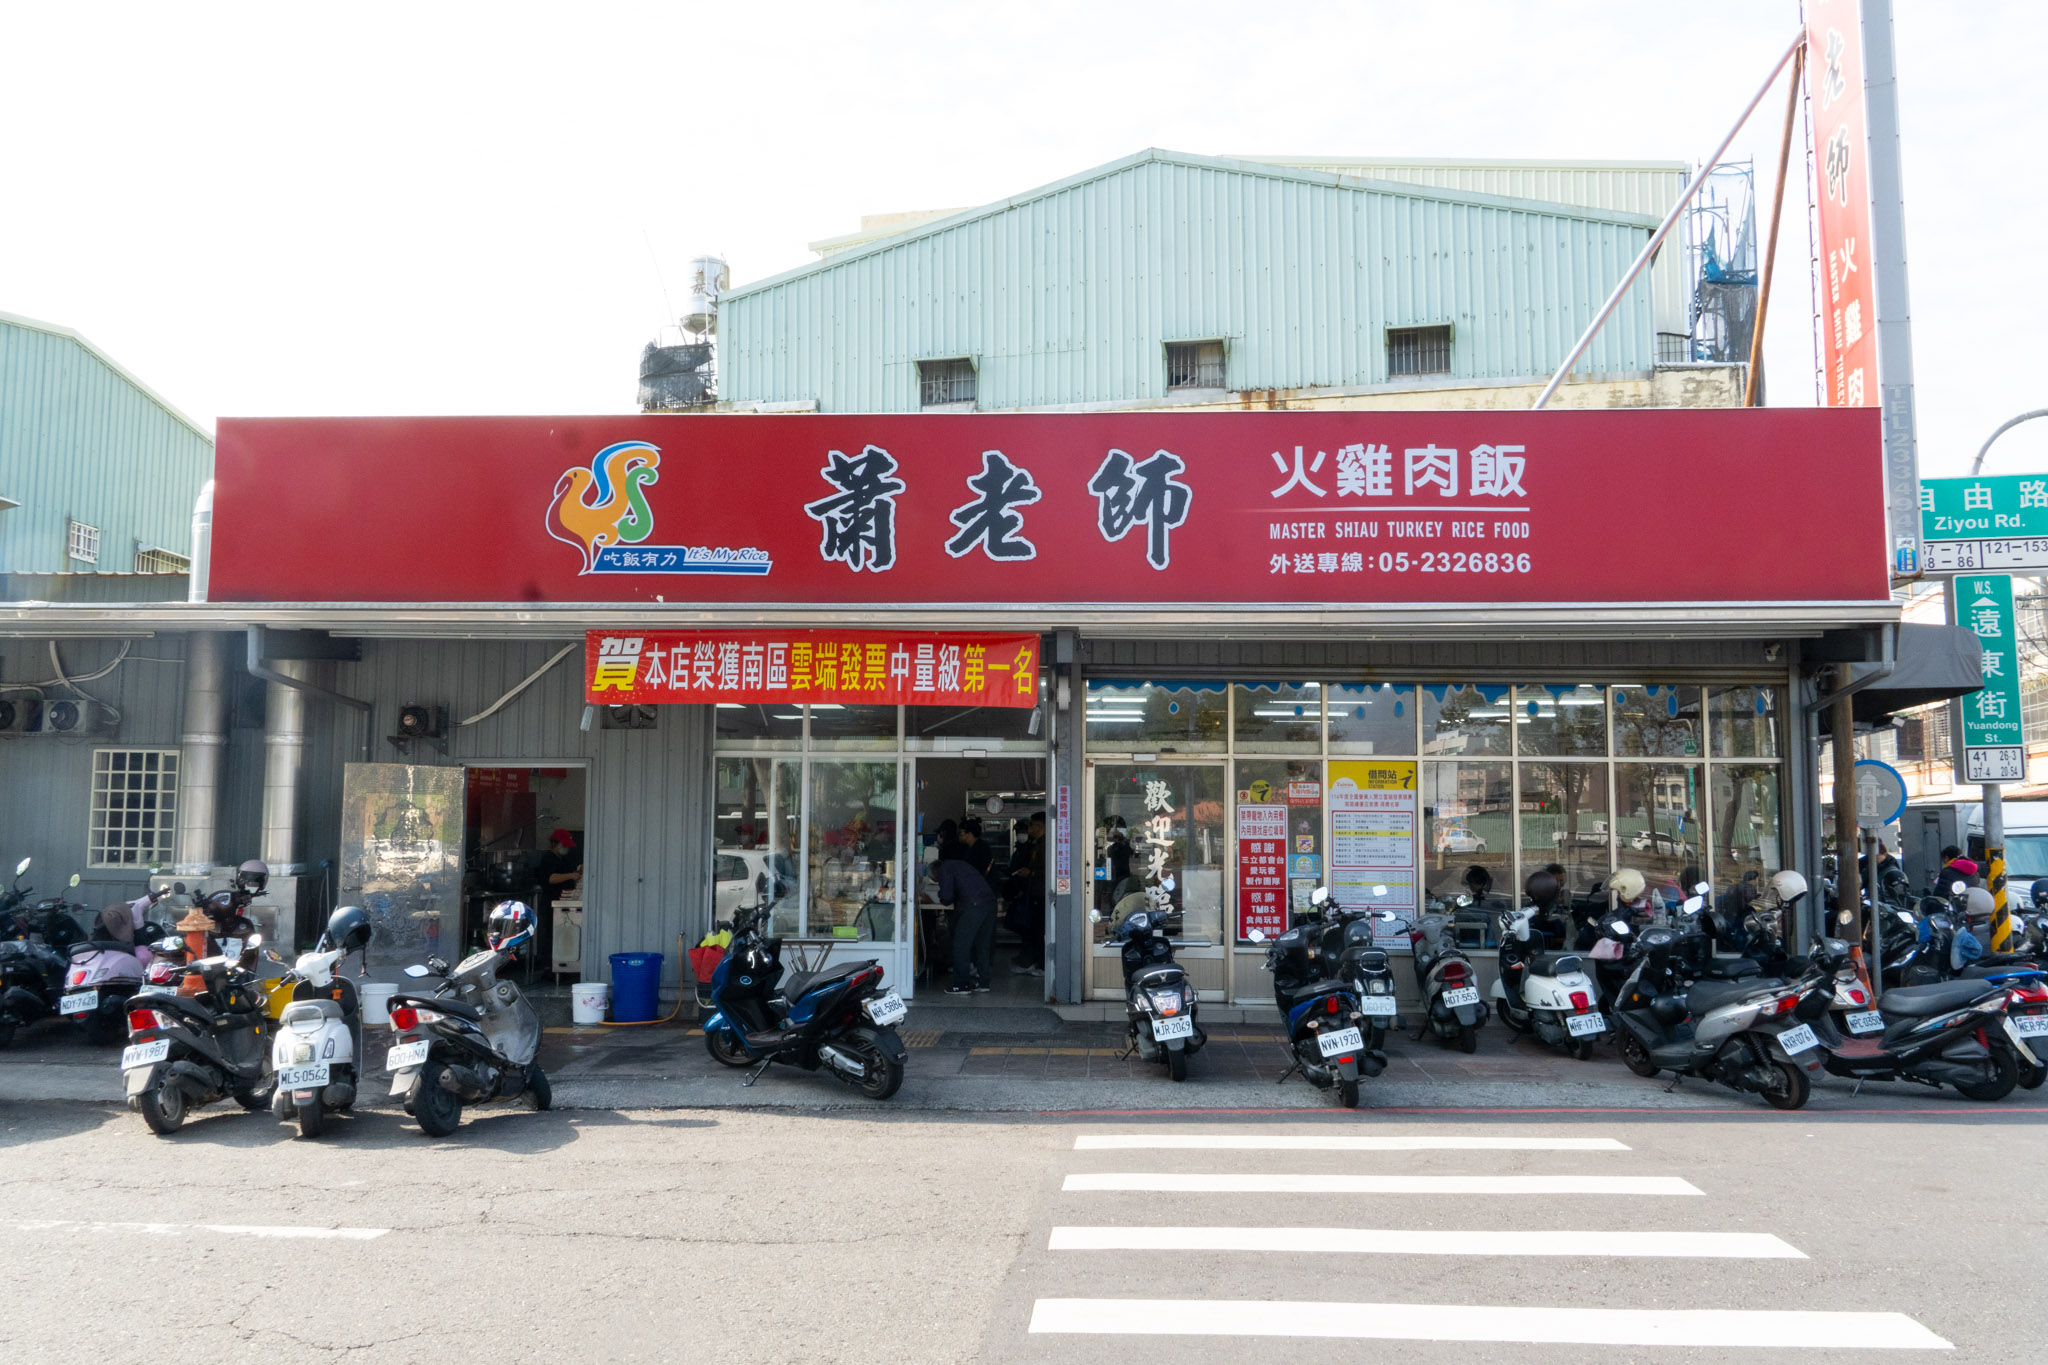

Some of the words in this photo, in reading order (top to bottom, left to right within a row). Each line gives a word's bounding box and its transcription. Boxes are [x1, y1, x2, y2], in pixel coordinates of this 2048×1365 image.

[1270, 443, 1528, 498] 火雞肉飯
[1891, 432, 1914, 537] 233494
[1920, 480, 2048, 512] 自由路
[804, 444, 1193, 571] 蕭老師
[1269, 522, 1326, 540] MASTER
[1335, 521, 1379, 539] SHIAU
[1387, 521, 1443, 539] TURKEY
[1451, 521, 1485, 539] RICE
[1494, 521, 1530, 539] FOOD
[1934, 515, 1989, 533] Ziyou
[1994, 513, 2026, 528] Rd.
[603, 551, 678, 567] 吃飯有力
[687, 547, 711, 561] It's
[712, 548, 736, 564] My
[738, 547, 769, 561] Rice
[1973, 580, 1994, 595] W.S.
[591, 636, 645, 692] 賀
[644, 640, 1033, 695] 本店榮獲南區雲端發票中量級第一名
[1970, 608, 2007, 720] 遠東街
[1967, 721, 2019, 731] Yuandong
[1984, 733, 2002, 743] St.
[1973, 751, 1988, 762] 41
[1999, 750, 2017, 761] 26-3
[1368, 769, 1397, 780] 借問站
[1973, 767, 1991, 778] 37-4
[1144, 779, 1175, 915] 歡迎光臨
[1250, 842, 1275, 853] 感謝
[1241, 856, 1285, 865] 三立都會台
[1250, 866, 1276, 875] 愛玩客
[1245, 877, 1281, 886] 製作團隊
[1251, 892, 1275, 903] 感謝
[1246, 916, 1281, 924] 食尚玩家
[1154, 1021, 1191, 1037] MJR-2069
[1320, 1034, 1361, 1053] NVN-1920
[280, 1068, 328, 1085] MLS-0562
